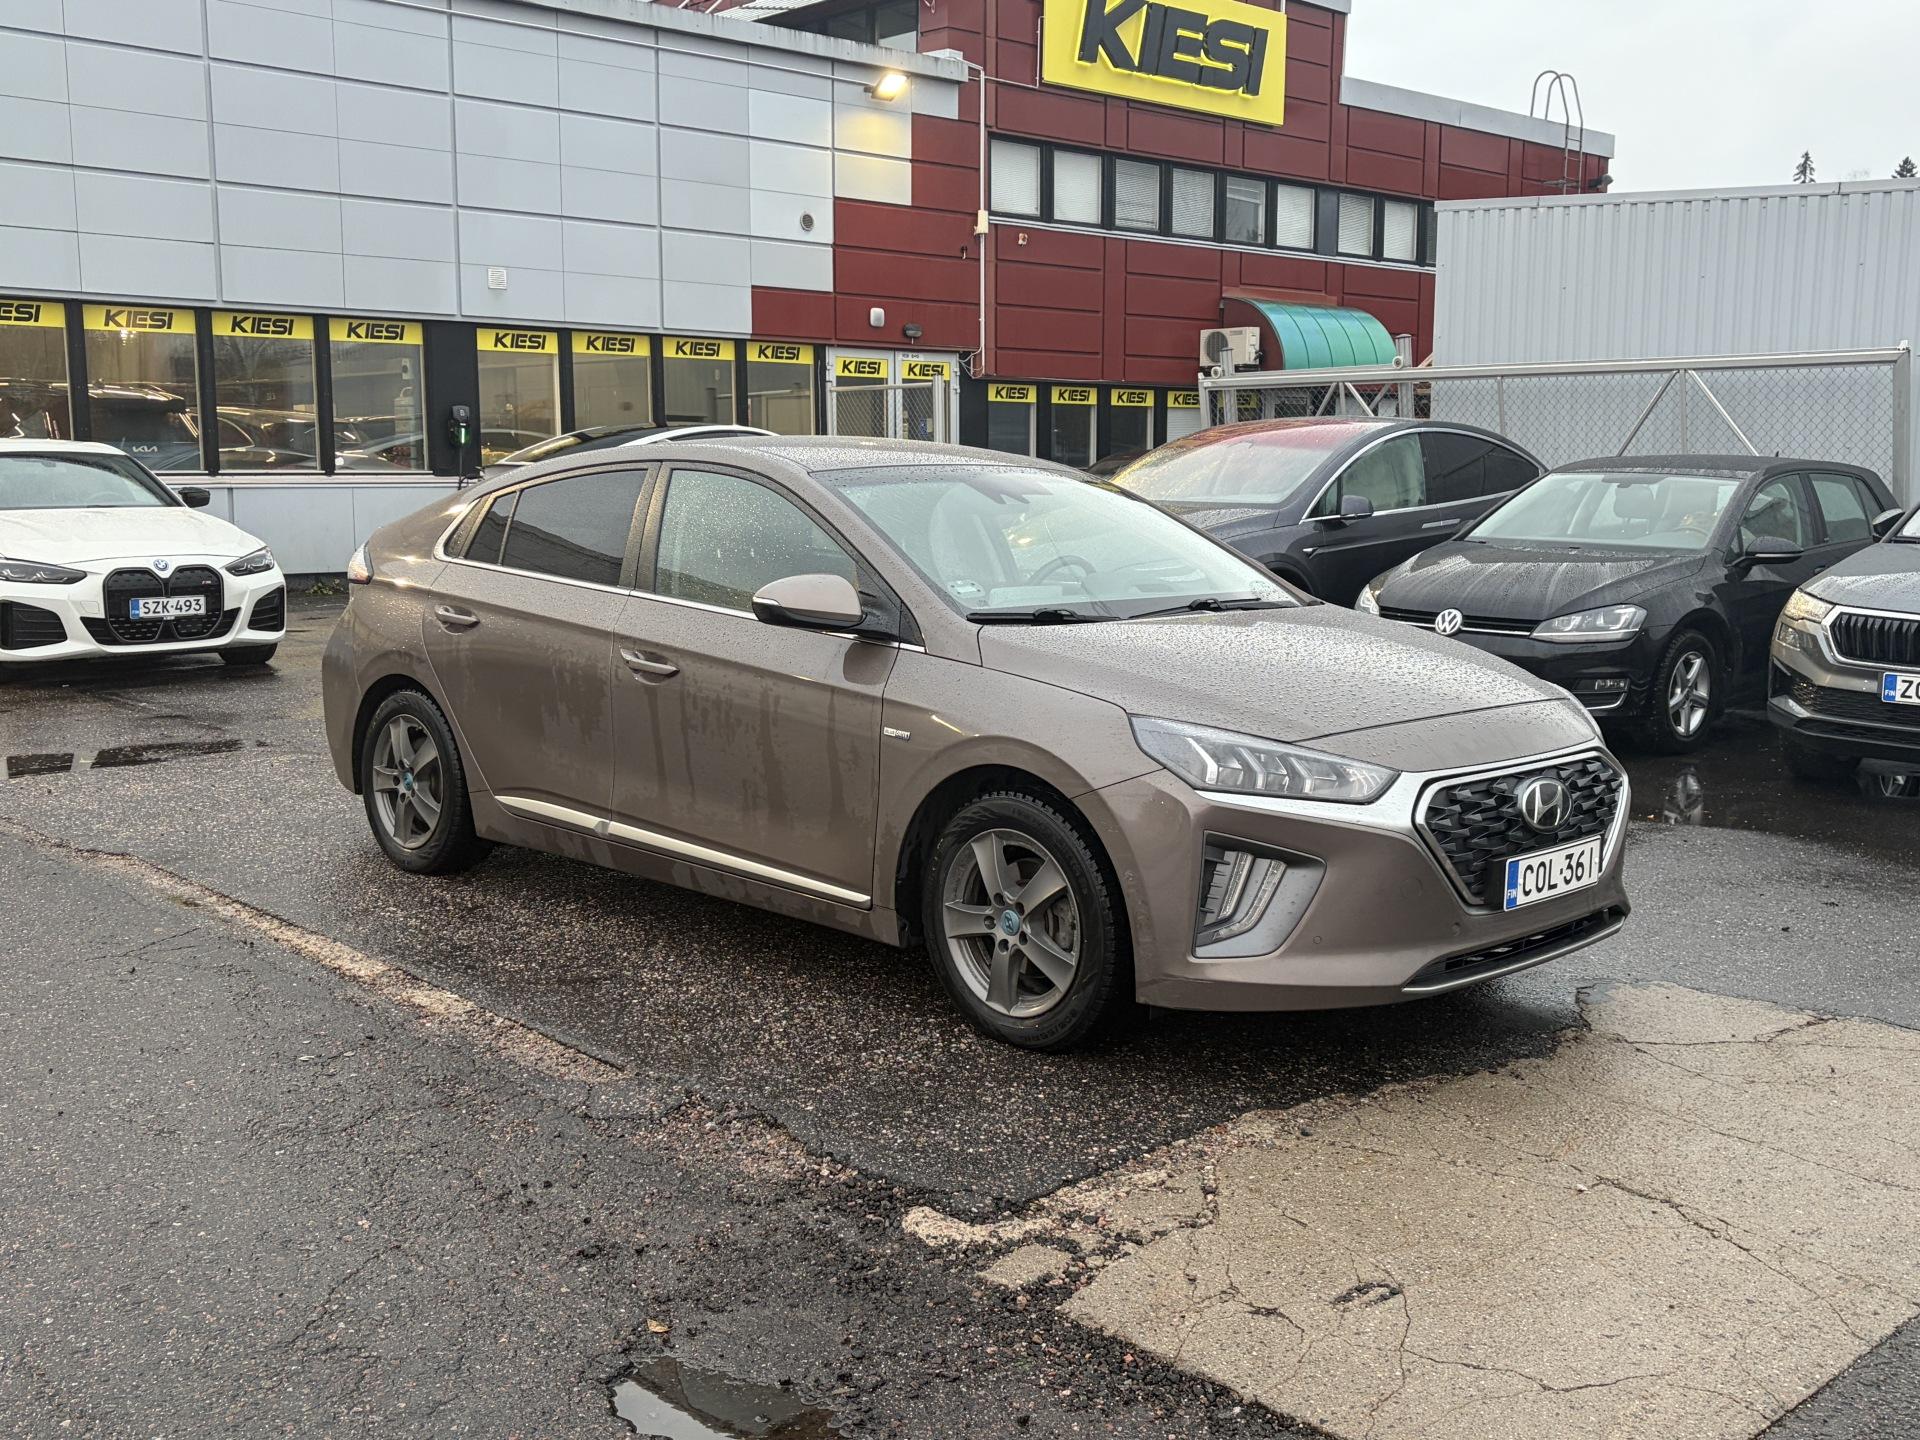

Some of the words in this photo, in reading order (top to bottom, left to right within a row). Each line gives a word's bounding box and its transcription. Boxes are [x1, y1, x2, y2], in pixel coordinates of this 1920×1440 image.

[1077, 0, 1269, 96] KIESI
[0, 302, 41, 322] ESI
[104, 309, 173, 330] KIESI
[231, 315, 295, 336] KIESI
[346, 321, 406, 341] KIESI
[494, 332, 547, 350] KIESI
[586, 335, 636, 353] KIESI
[675, 340, 721, 358] KIESI
[758, 344, 801, 361] KIESI
[842, 359, 881, 375] KIESI
[908, 363, 945, 376] KIESI
[994, 385, 1029, 401] KIESI
[1058, 388, 1091, 402] KIESI
[1117, 391, 1148, 404] KIESI
[1173, 393, 1200, 406] KIES
[142, 598, 202, 615] SZK-493
[1522, 846, 1594, 897] COL-361
